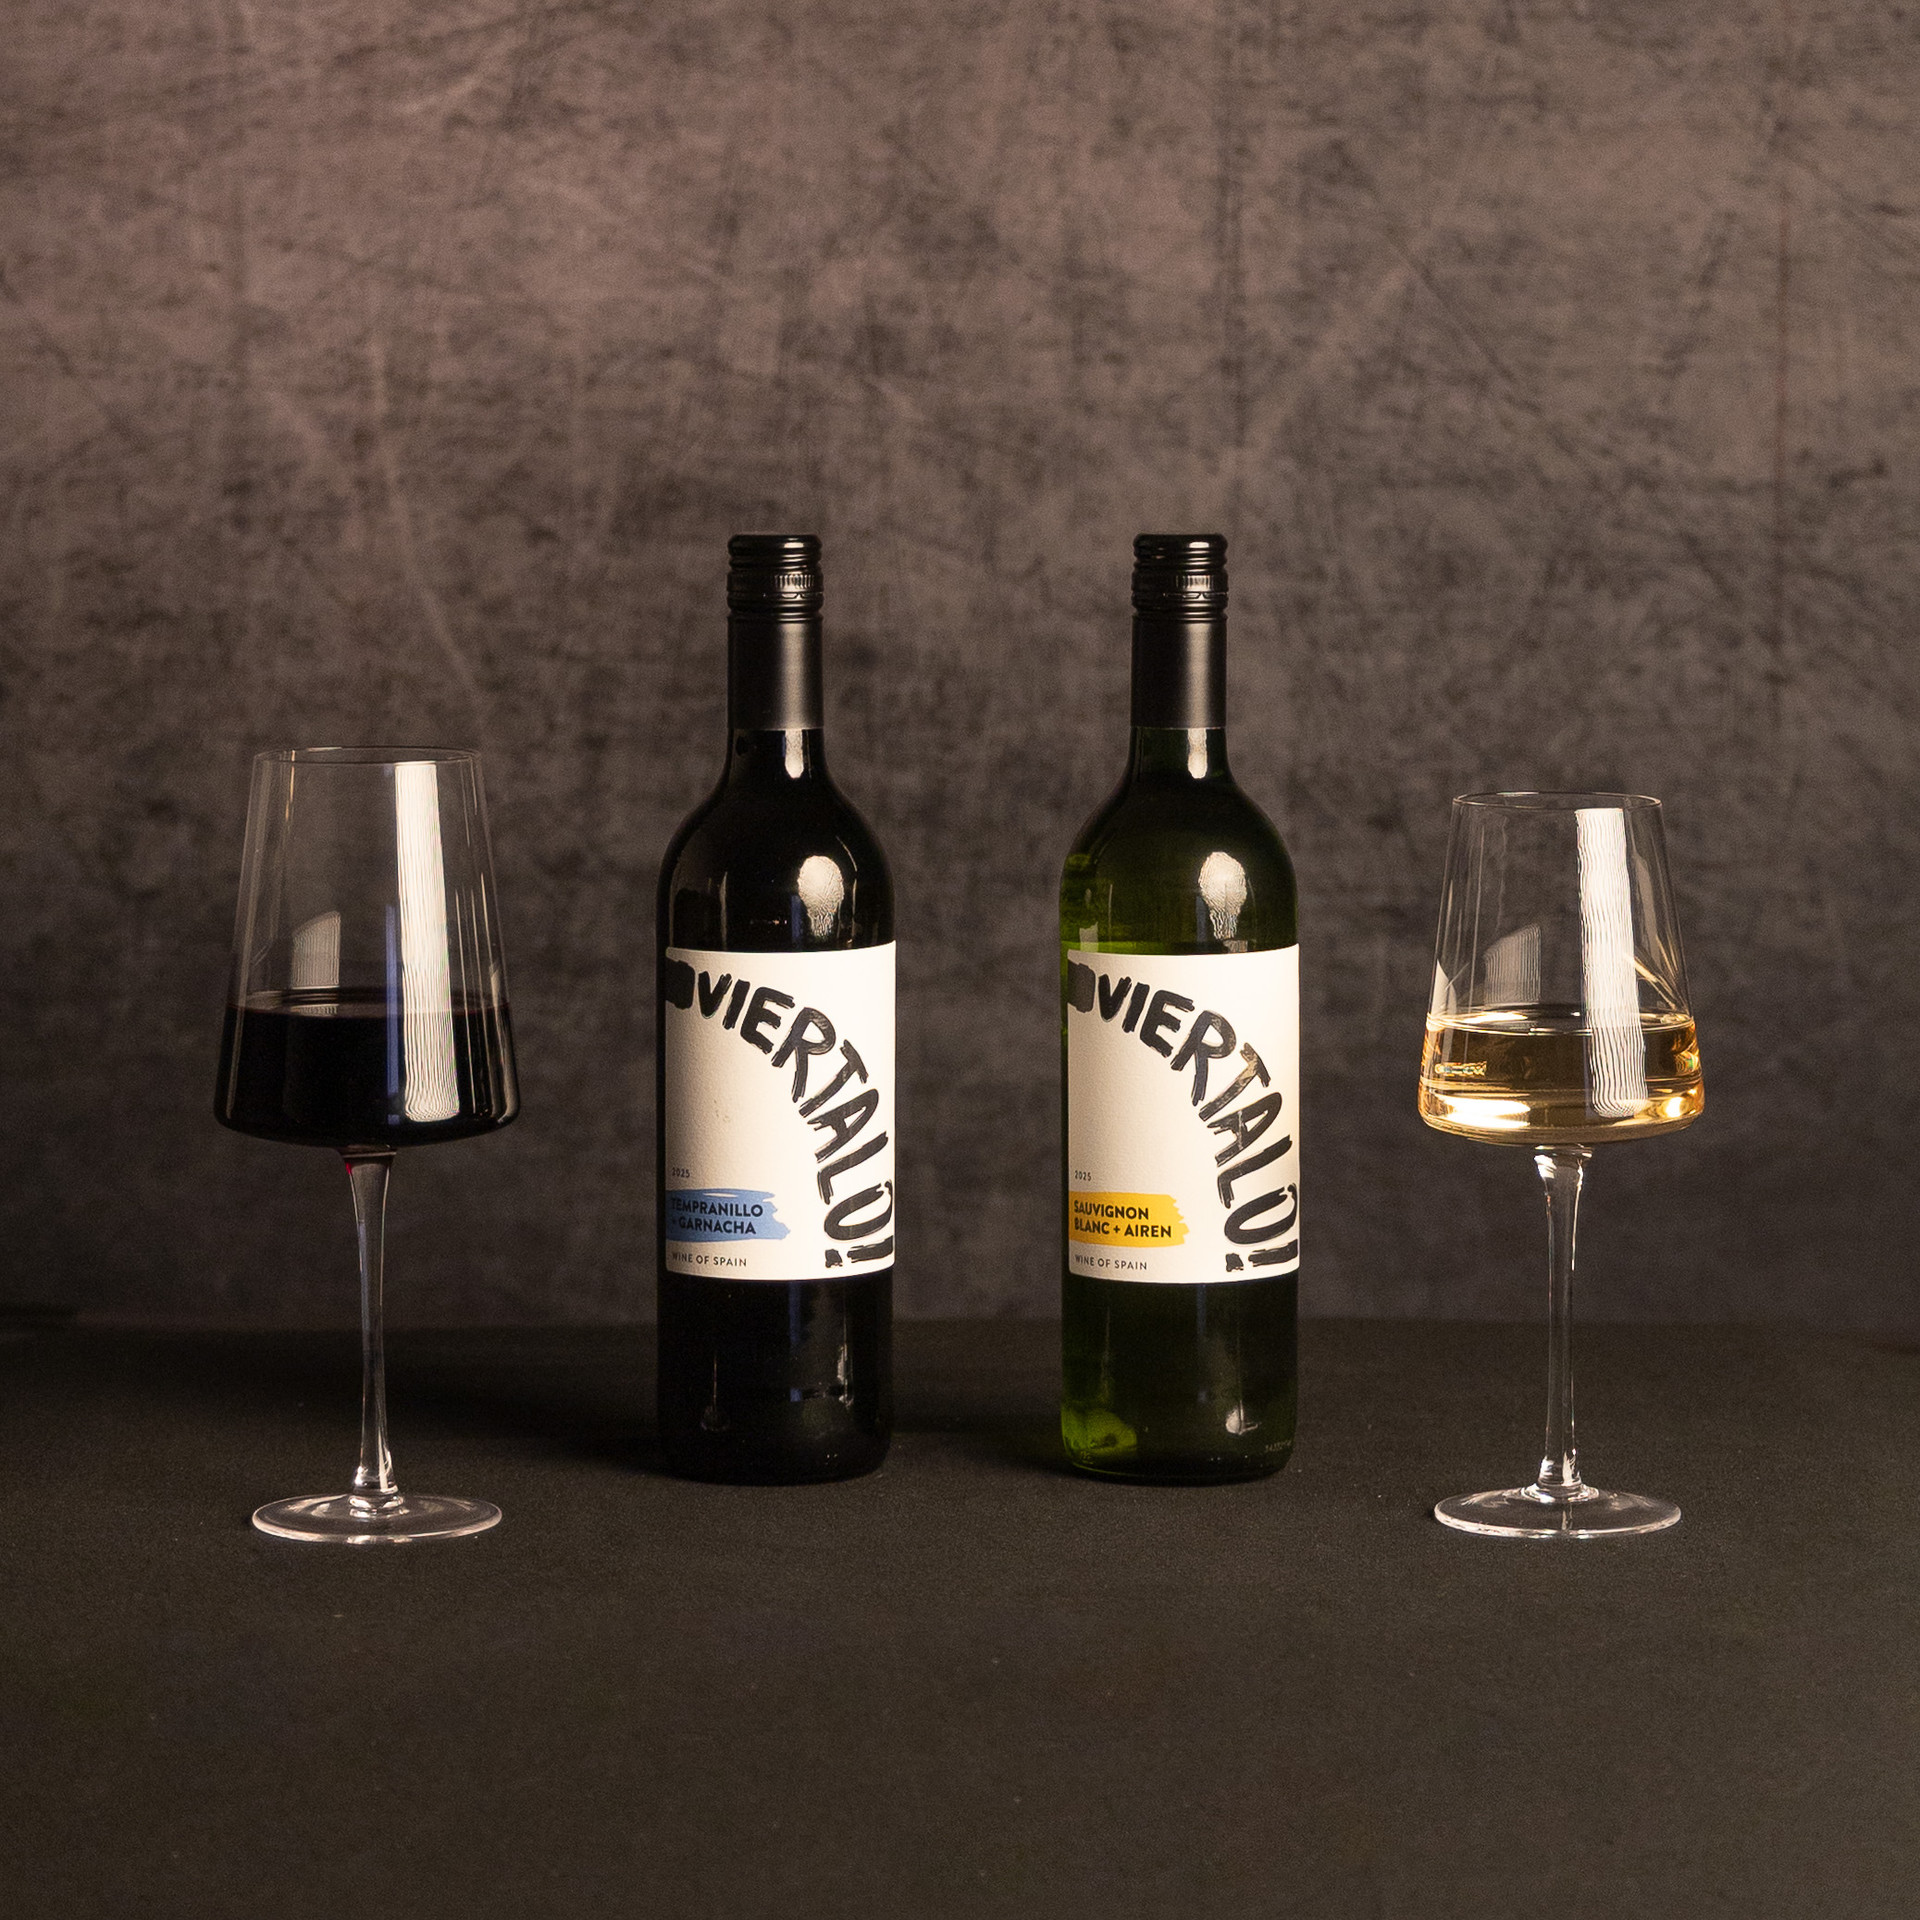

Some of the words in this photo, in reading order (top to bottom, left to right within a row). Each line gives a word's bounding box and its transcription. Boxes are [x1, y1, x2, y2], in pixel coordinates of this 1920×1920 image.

[671, 1167, 690, 1178] 2025
[1074, 1170, 1092, 1182] 2025
[671, 1198, 763, 1217] TEMPRANILLO
[1073, 1200, 1149, 1220] SAUVIGNON
[678, 1216, 756, 1234] GARNACHA
[1074, 1217, 1110, 1235] BLANC
[1124, 1224, 1172, 1238] AIREN
[671, 1252, 693, 1263] WINE
[696, 1255, 709, 1265] OF
[713, 1256, 747, 1267] SPAIN
[1074, 1254, 1095, 1267] WINE
[1097, 1257, 1111, 1268] OF
[1114, 1259, 1148, 1271] SPAIN
